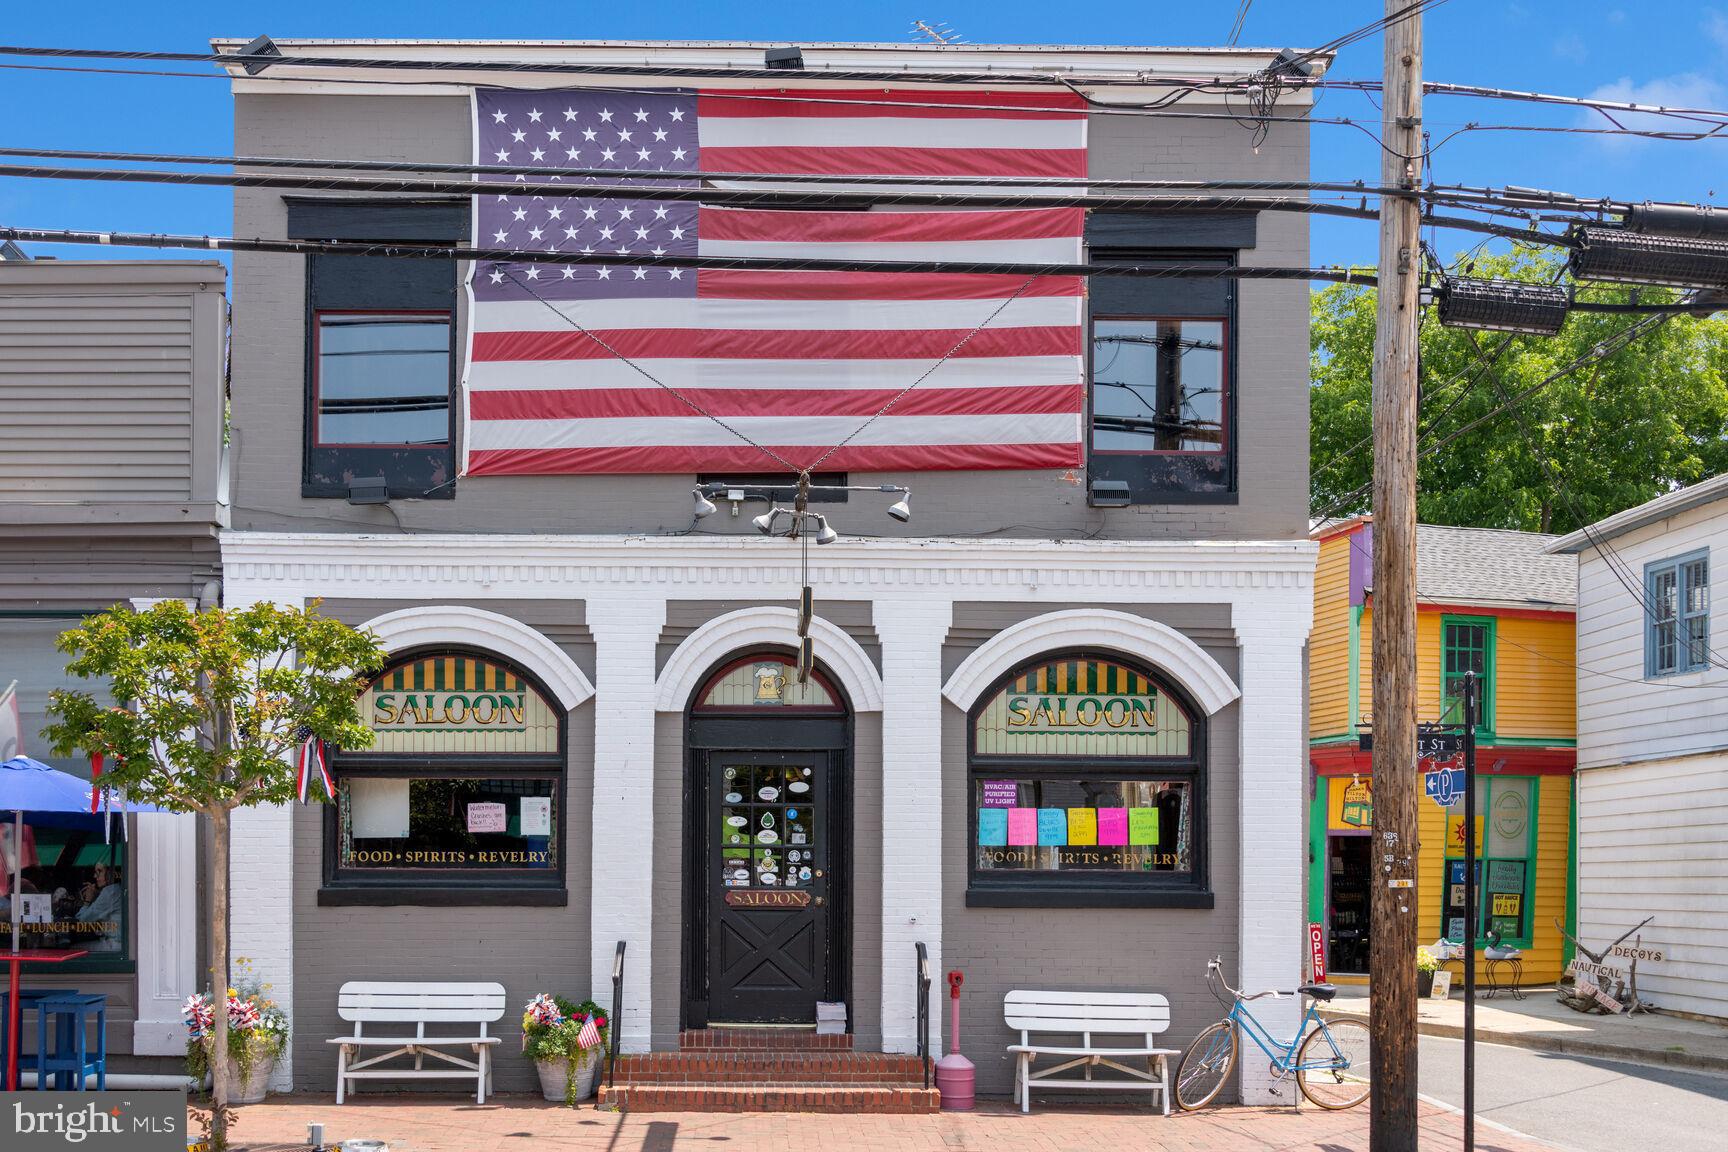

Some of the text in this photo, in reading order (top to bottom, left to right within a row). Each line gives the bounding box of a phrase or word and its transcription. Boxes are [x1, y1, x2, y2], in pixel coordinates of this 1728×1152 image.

[374, 694, 526, 725] SALOON
[1008, 697, 1156, 728] SALOON
[1441, 774, 1450, 796] P
[350, 851, 549, 864] FOOD SPIRITS REVELRY
[734, 892, 805, 905] SALOON
[31, 921, 70, 934] LUNCH
[76, 921, 119, 934] DINNER
[1312, 930, 1324, 977] OPEN
[1614, 946, 1662, 961] DECOYS
[1571, 960, 1622, 979] NAUTICAL
